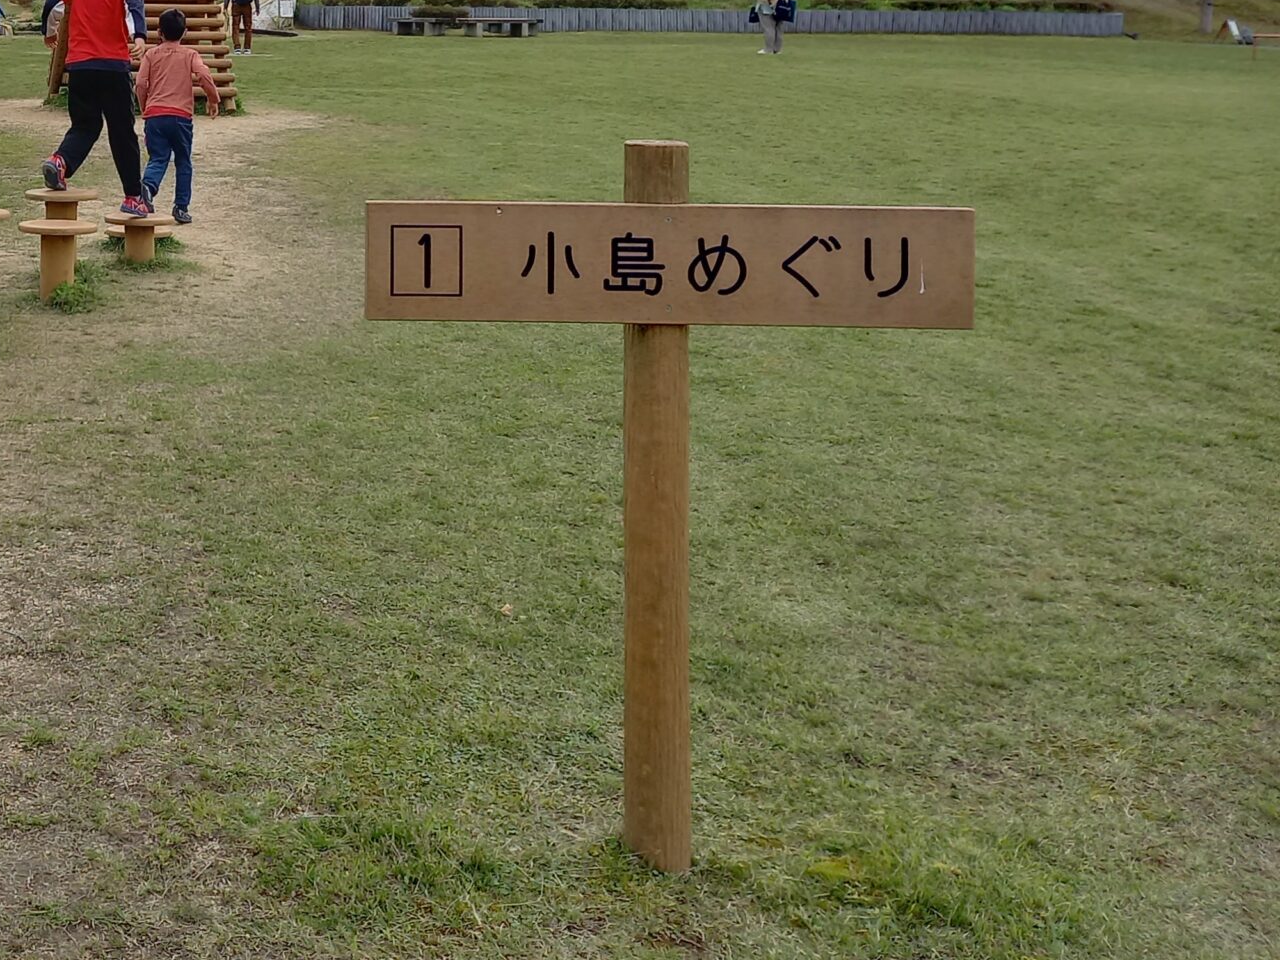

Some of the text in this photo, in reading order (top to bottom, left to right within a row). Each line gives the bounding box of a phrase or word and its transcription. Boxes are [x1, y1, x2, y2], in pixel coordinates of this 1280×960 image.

[520, 230, 909, 298] 小島めぐり
